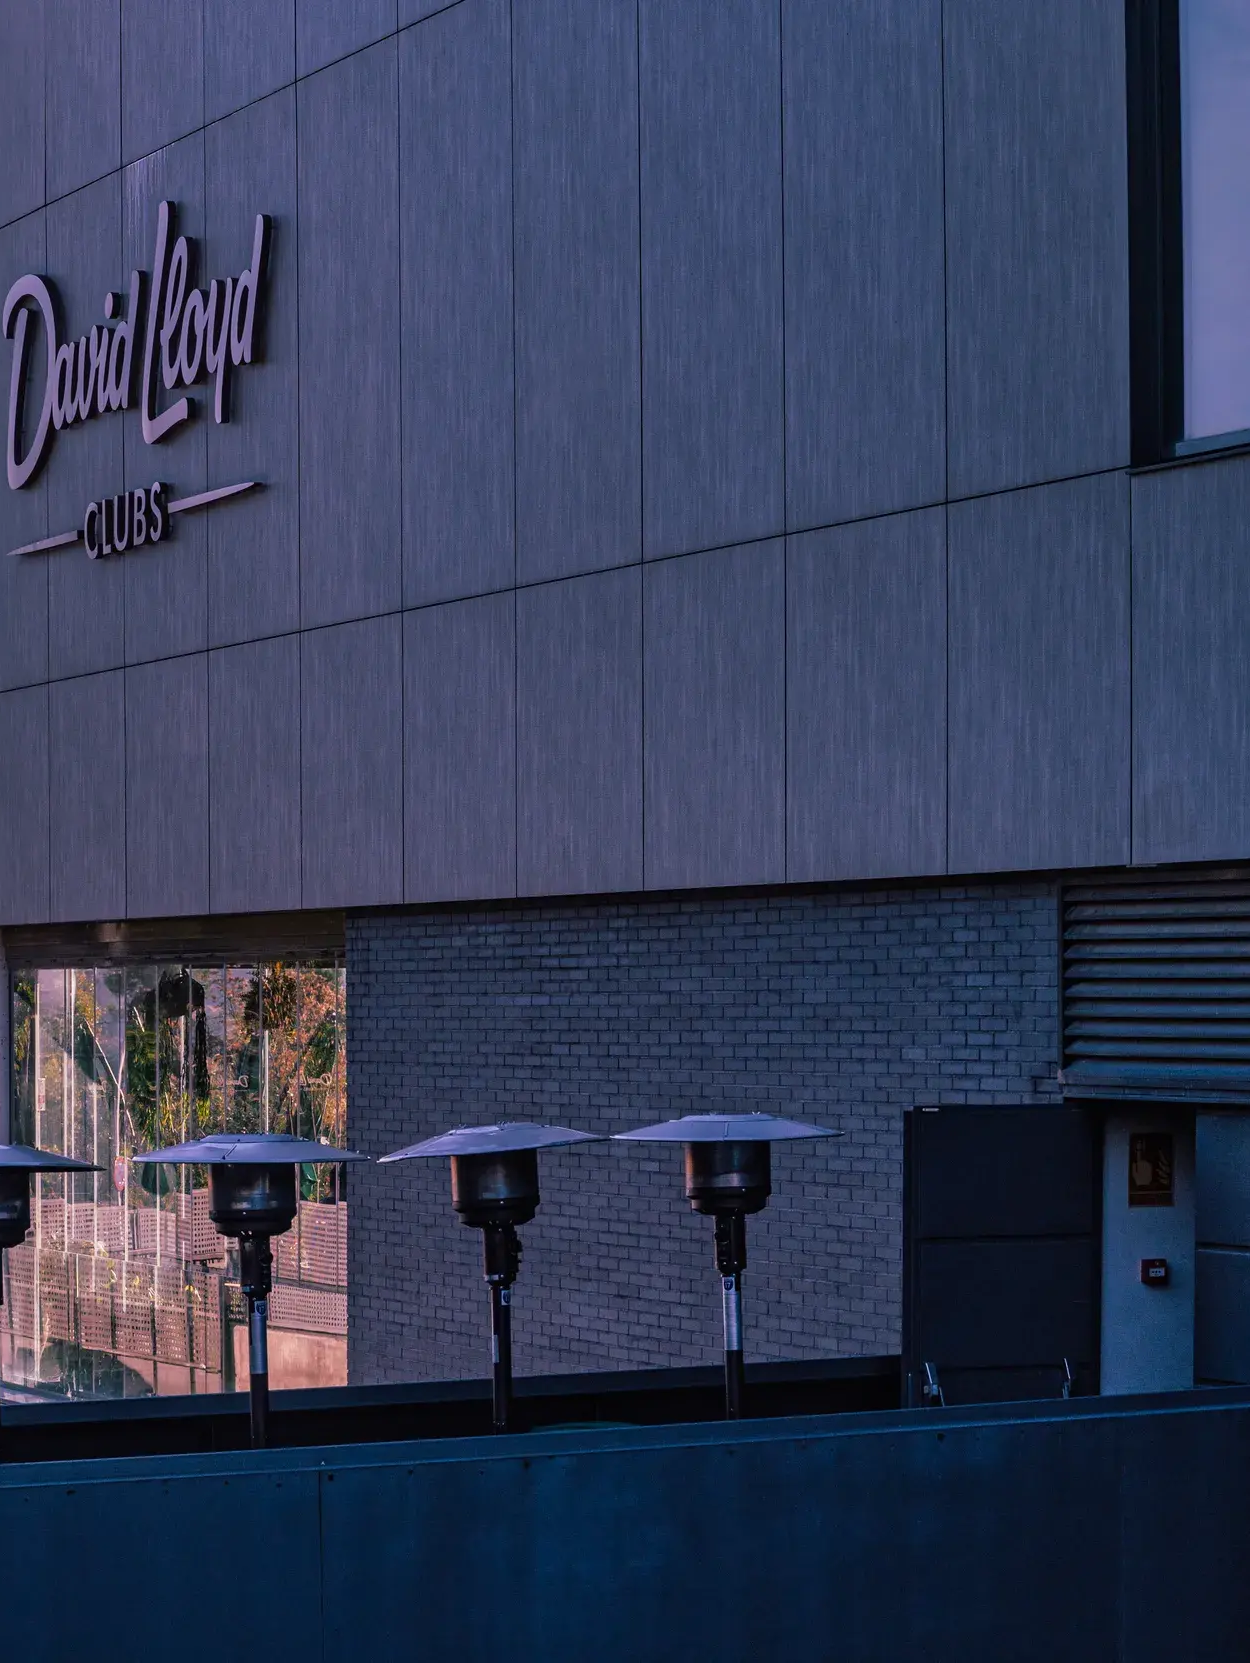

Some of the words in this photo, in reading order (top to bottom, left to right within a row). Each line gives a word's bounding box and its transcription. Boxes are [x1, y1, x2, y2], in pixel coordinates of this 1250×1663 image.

[3, 270, 142, 489] David
[142, 201, 268, 444] Lloyd
[84, 481, 166, 560] CLUBS
